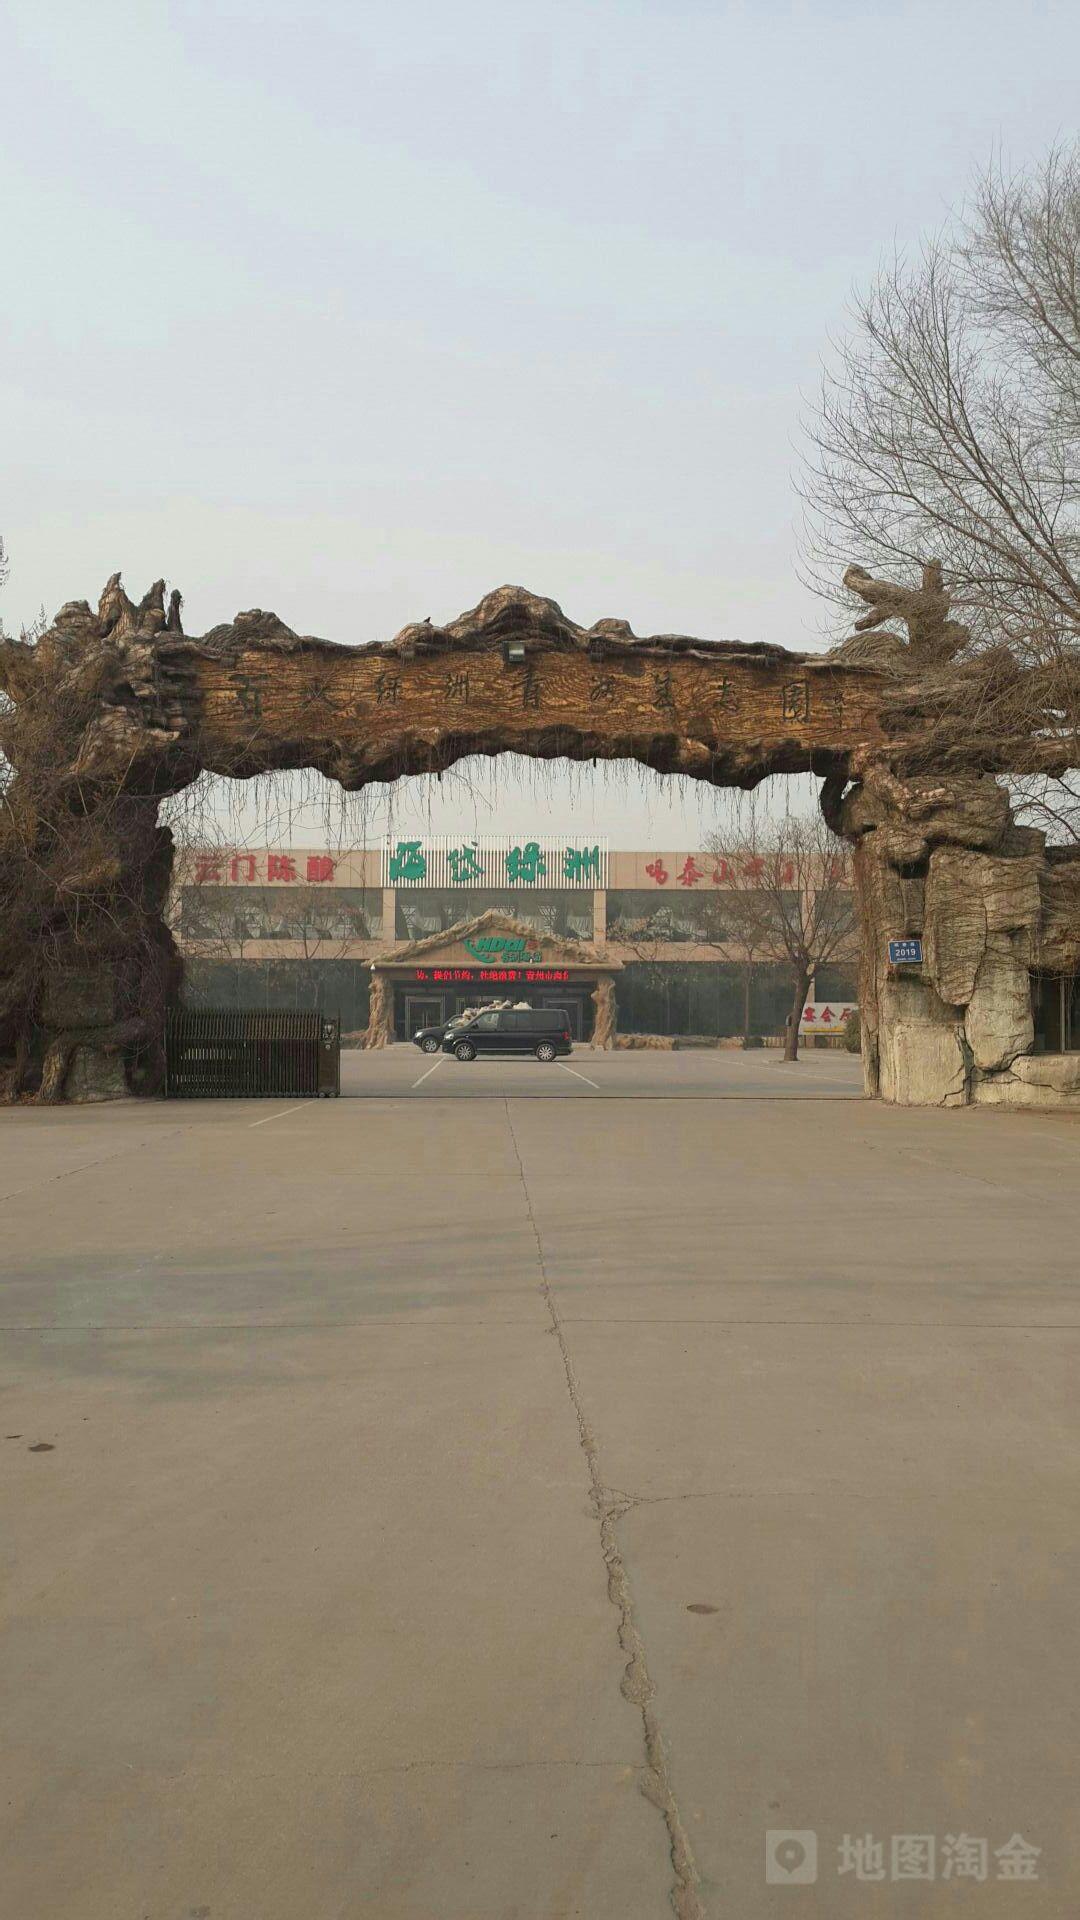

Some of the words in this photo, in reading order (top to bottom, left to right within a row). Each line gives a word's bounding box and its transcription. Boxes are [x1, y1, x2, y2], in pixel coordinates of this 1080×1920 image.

[195, 855, 335, 882] 云门陈酿
[895, 948, 916, 957] 2019
